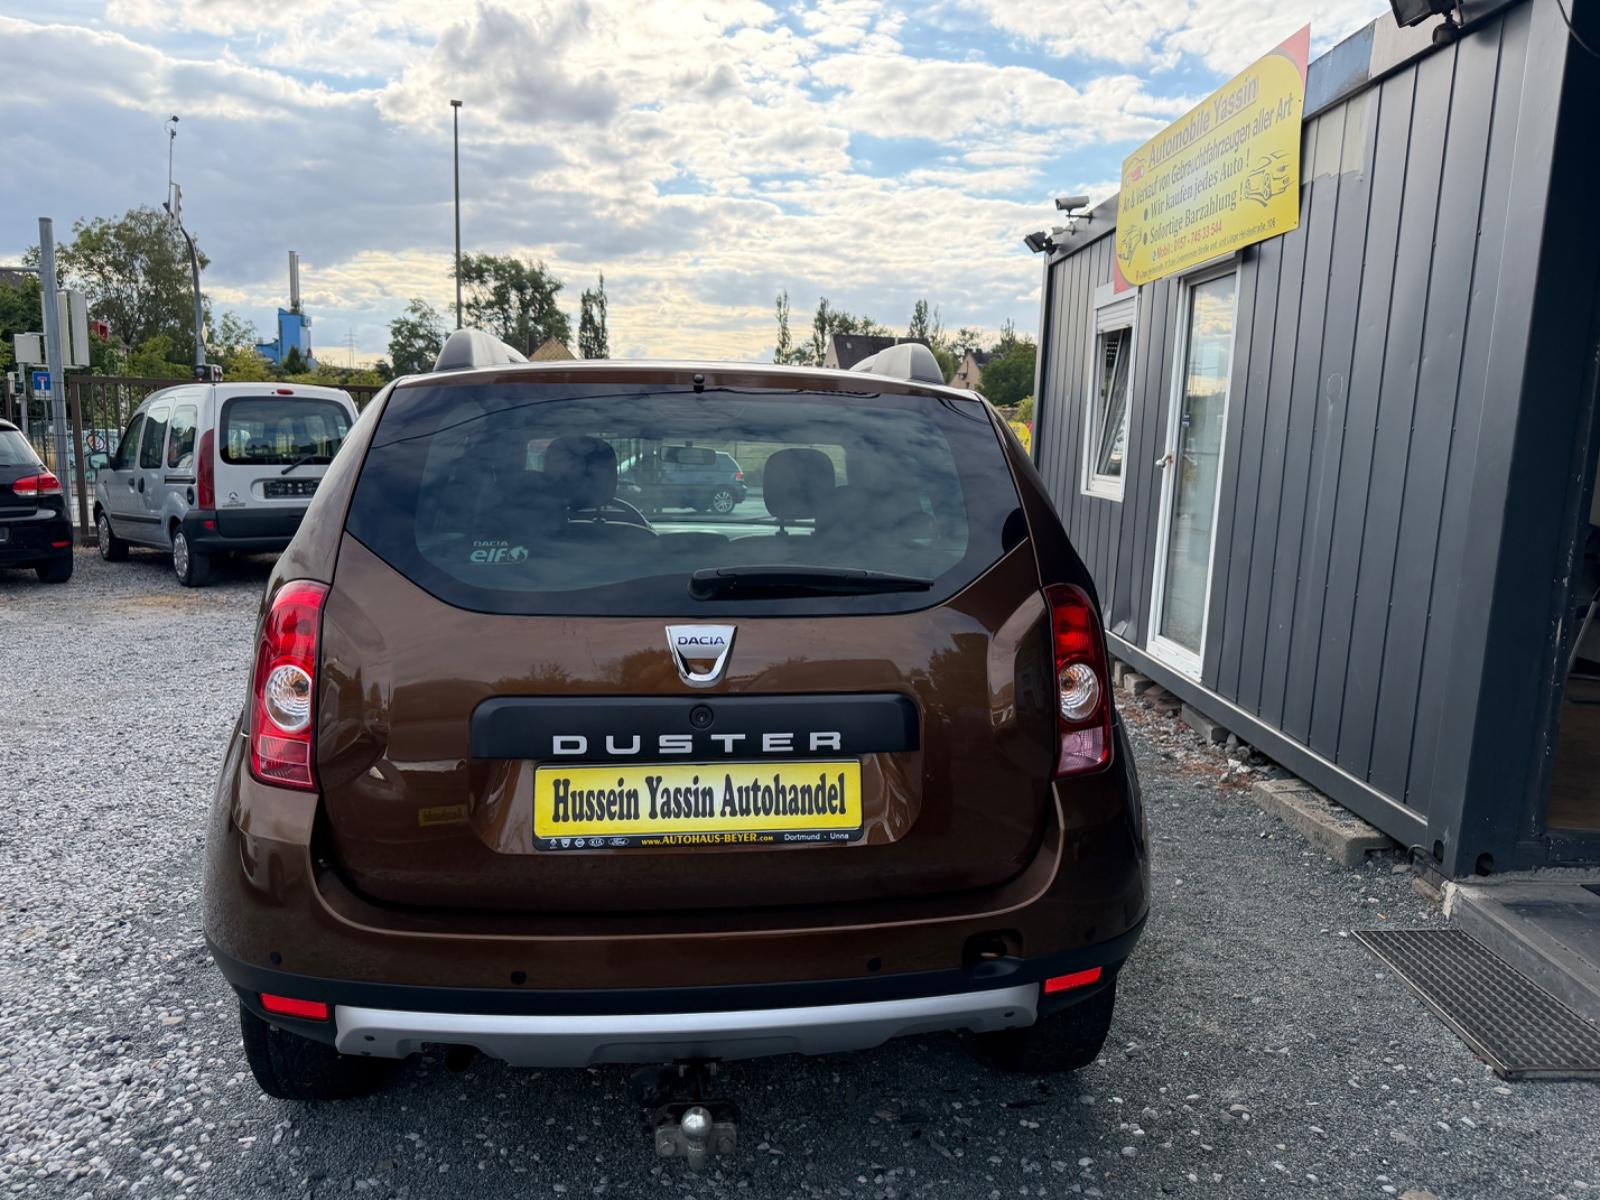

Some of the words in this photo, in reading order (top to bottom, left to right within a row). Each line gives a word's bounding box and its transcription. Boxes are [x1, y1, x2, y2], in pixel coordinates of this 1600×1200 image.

[1149, 109, 1209, 167] Automobile
[1213, 76, 1258, 123] Yassin
[1252, 106, 1275, 136] aller
[1276, 92, 1293, 123] Art
[1151, 198, 1164, 217] Wir
[1166, 184, 1192, 210] kaufen
[1194, 170, 1218, 200] jedes
[1220, 156, 1243, 182] Auto
[1150, 216, 1183, 243] Sofortige
[1185, 190, 1237, 228] Barzahlung
[677, 635, 726, 646] DACIA
[552, 731, 842, 755] DUSTER
[551, 778, 640, 823] Hussein
[644, 775, 715, 819] Yassin
[720, 773, 847, 817] Autohandel
[784, 833, 820, 841] Dortmund
[830, 832, 849, 840] Unna
